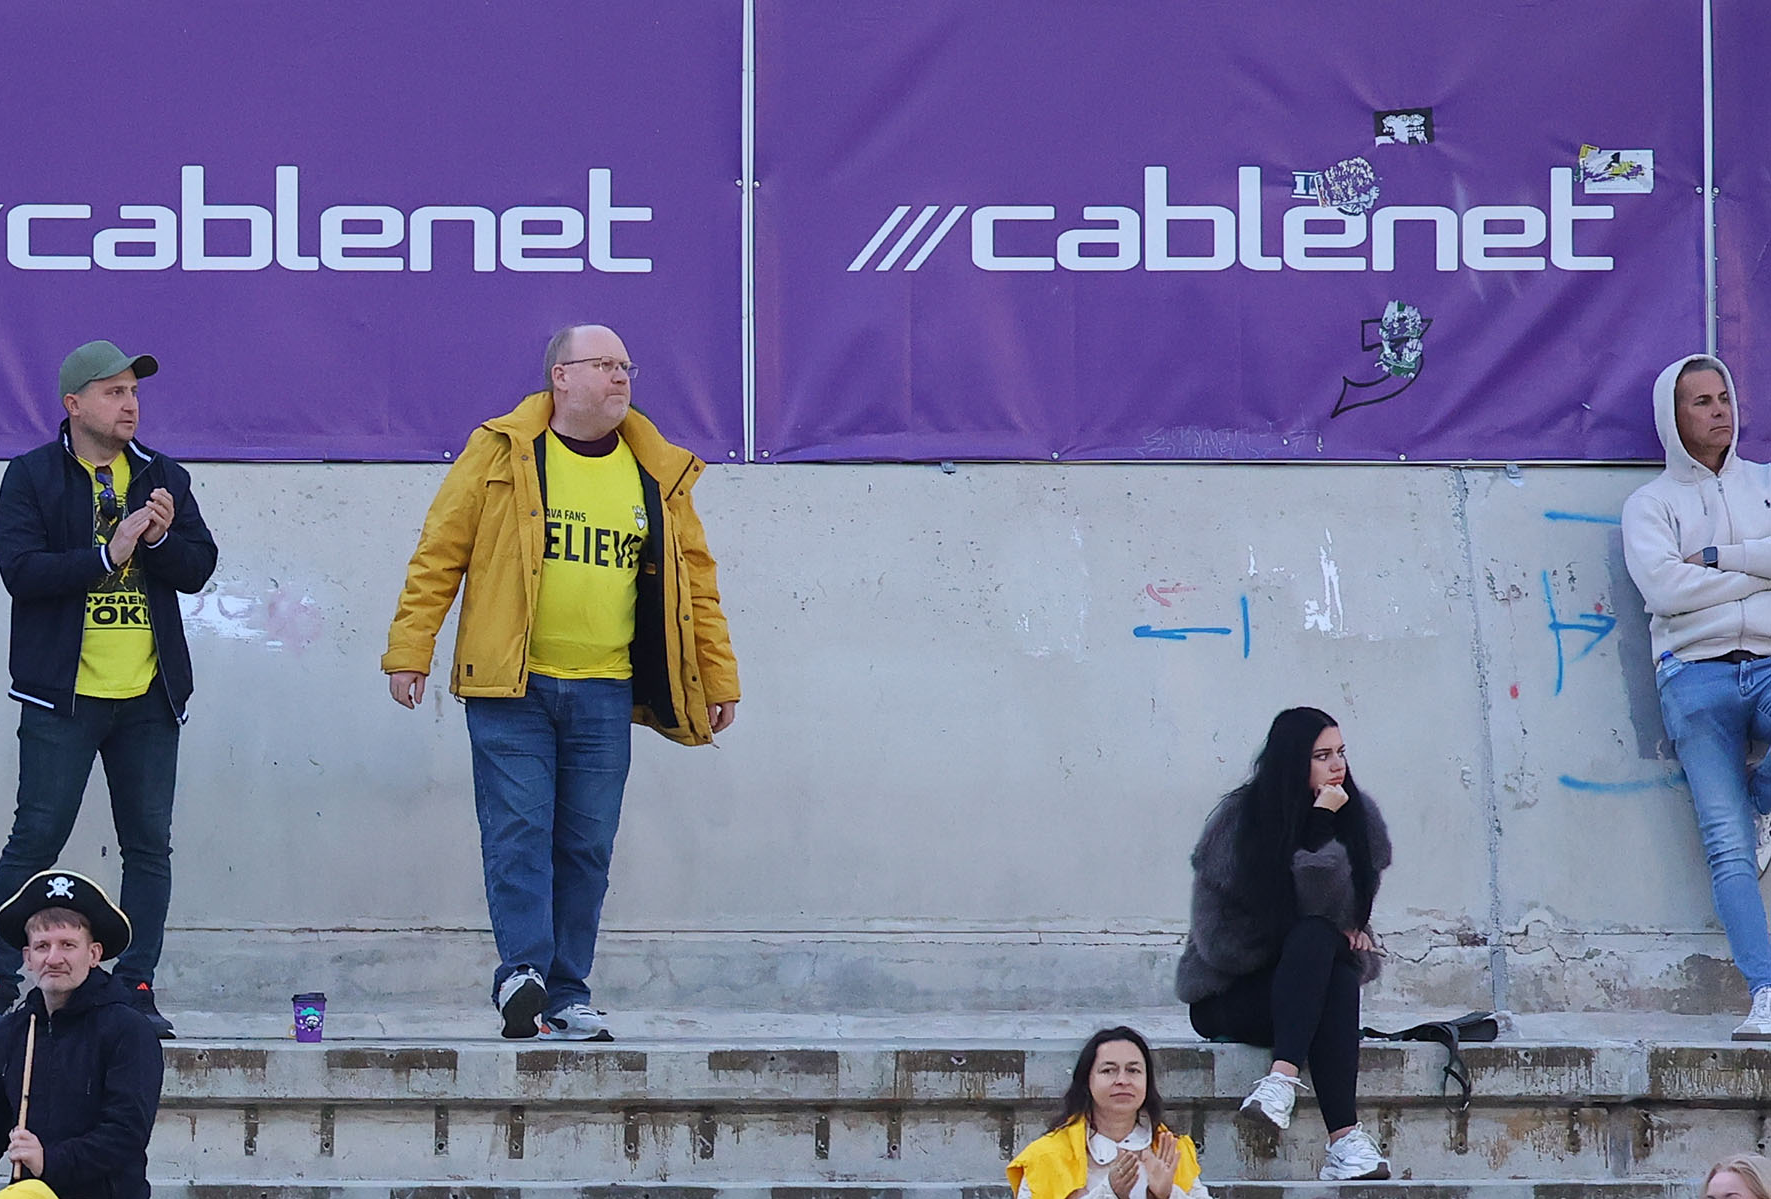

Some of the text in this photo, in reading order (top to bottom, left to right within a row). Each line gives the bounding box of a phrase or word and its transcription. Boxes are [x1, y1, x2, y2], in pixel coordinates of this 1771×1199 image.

[8, 166, 651, 273] cablenet
[972, 167, 1613, 271] cablenet
[564, 509, 586, 522] FANS
